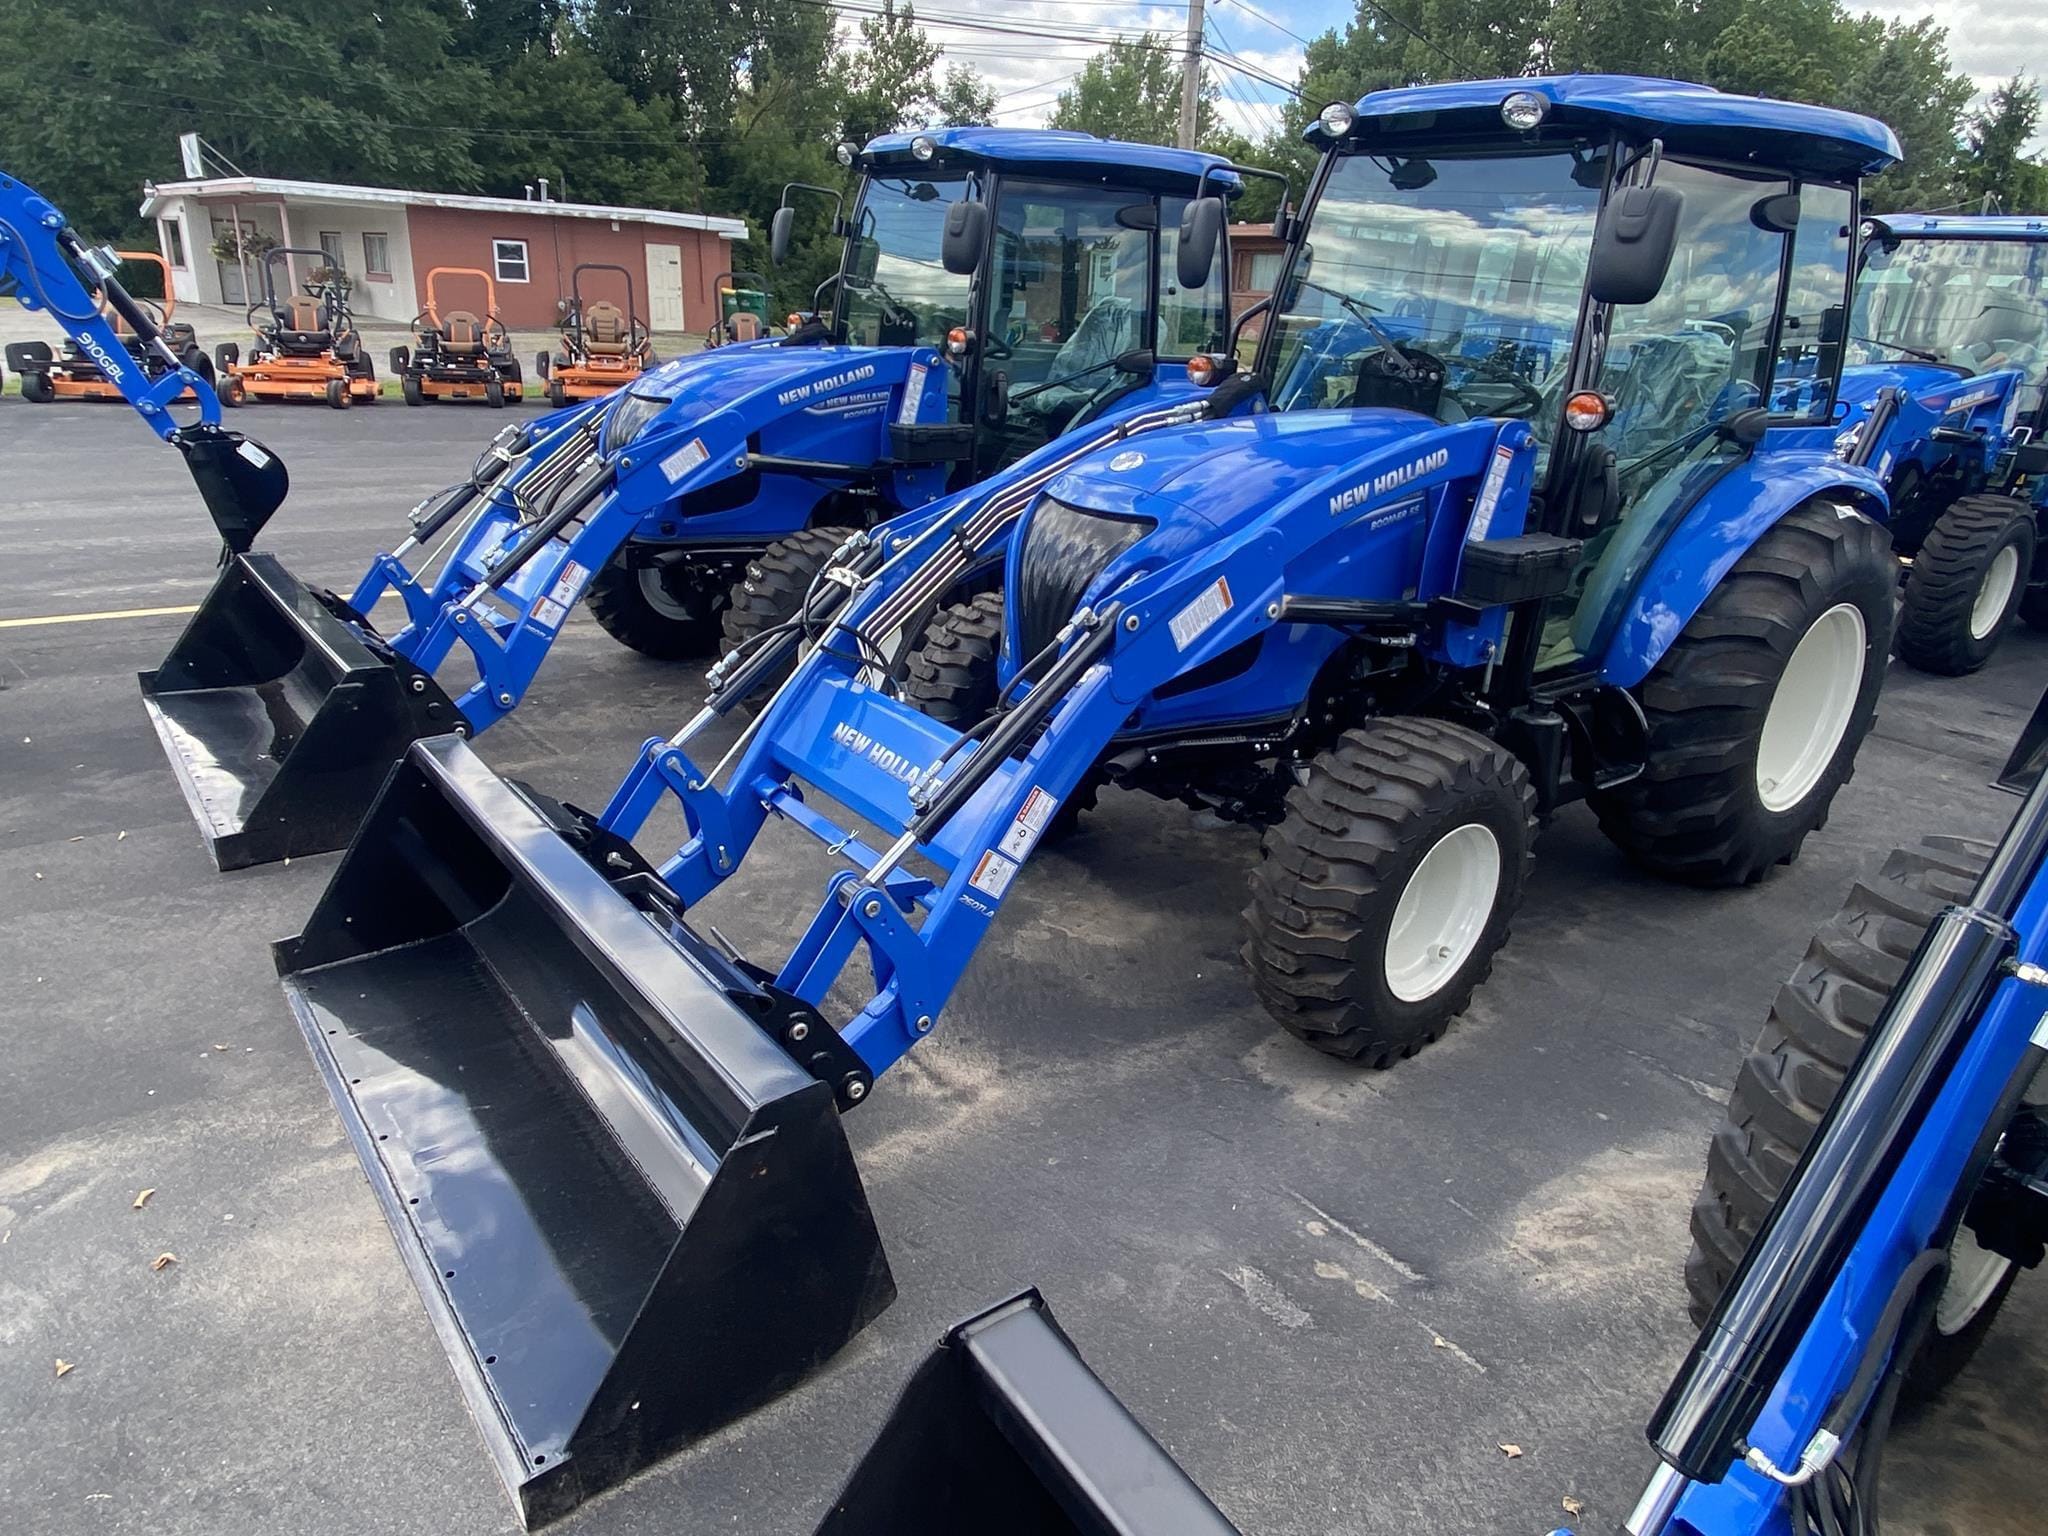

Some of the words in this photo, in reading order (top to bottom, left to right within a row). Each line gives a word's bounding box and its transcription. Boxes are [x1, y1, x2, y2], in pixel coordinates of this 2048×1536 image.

[77, 332, 124, 384] 910GBL
[778, 385, 811, 406] NEW
[813, 364, 875, 395] HOLLAND
[826, 396, 848, 408] NEW
[1329, 482, 1370, 516] NEW
[1374, 448, 1448, 496] HOLLAND
[1370, 509, 1408, 531] BOOMER
[832, 721, 872, 755] NEW
